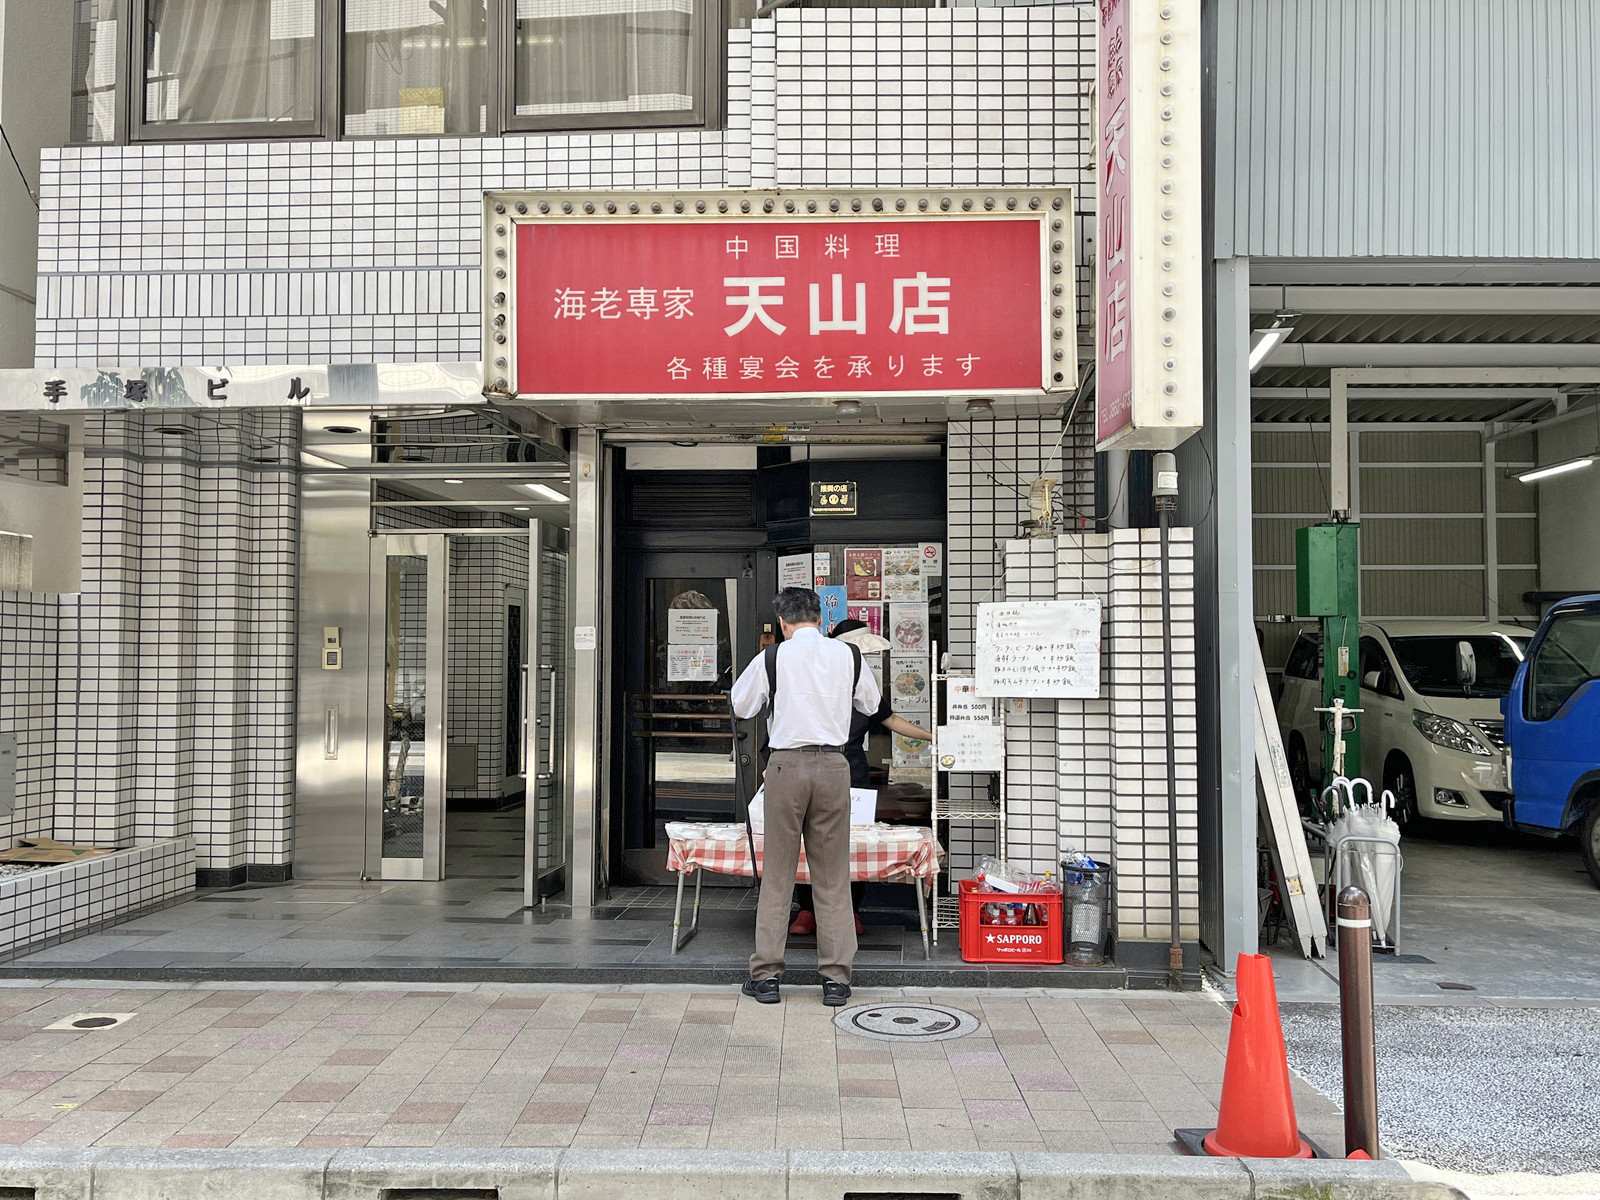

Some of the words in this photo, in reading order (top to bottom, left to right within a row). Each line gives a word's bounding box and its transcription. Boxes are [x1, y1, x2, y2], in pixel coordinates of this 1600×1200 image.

[1104, 99, 1128, 365] 天山店
[726, 233, 901, 260] 中国料理
[553, 287, 695, 320] 海老専家
[723, 271, 952, 337] 天山店
[666, 353, 982, 381] 各種宴会を承ります
[43, 376, 311, 403] 手塚ビル
[996, 934, 1042, 945] SAPPORO
